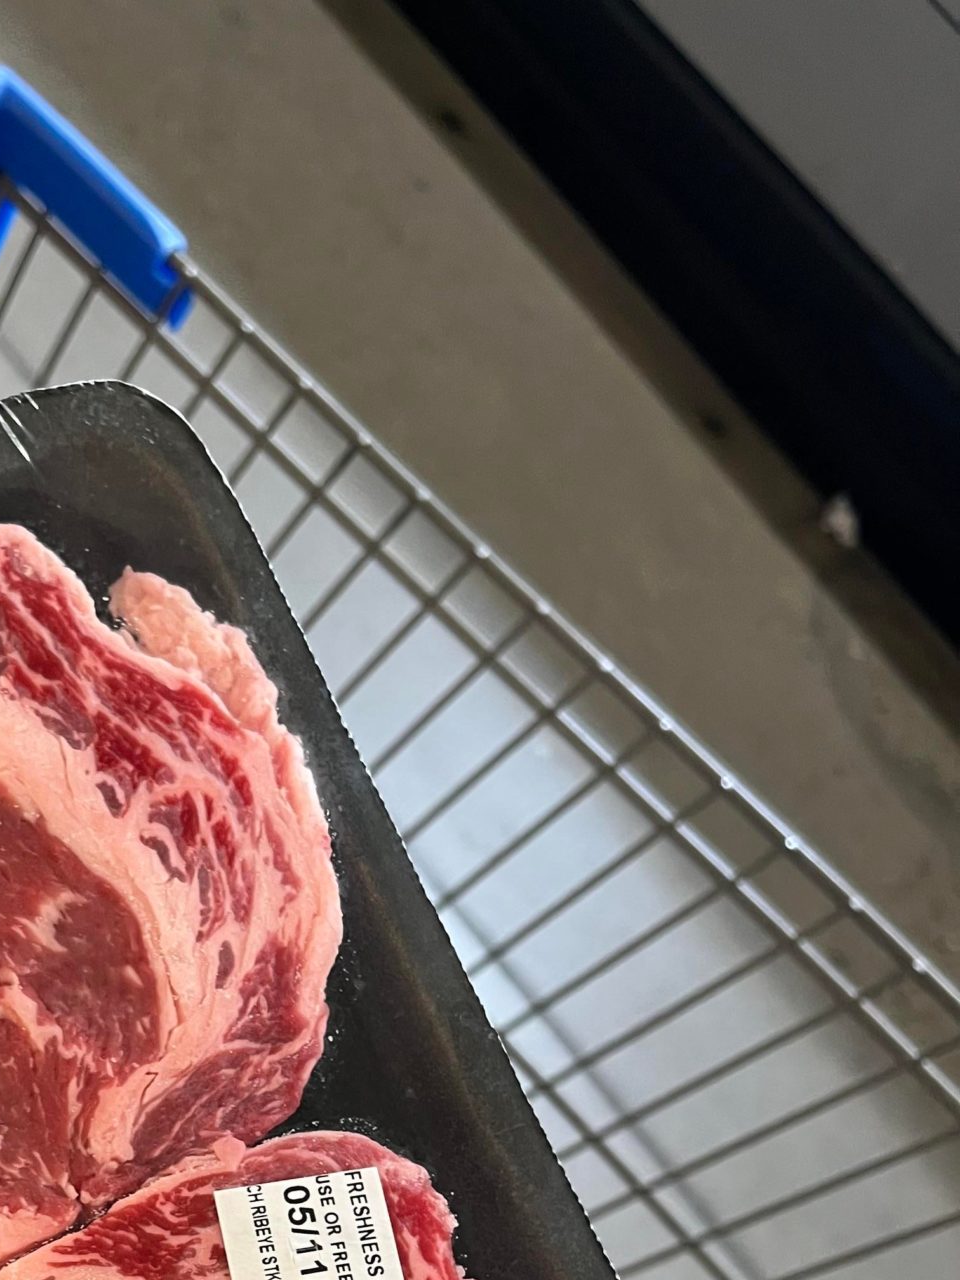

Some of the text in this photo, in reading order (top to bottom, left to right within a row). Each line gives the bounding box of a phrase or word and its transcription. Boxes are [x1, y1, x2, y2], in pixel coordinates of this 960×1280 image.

[246, 1184, 265, 1203] CH
[315, 1174, 336, 1207] USE
[250, 1205, 276, 1254] RIBEYE
[323, 1211, 342, 1236] OR
[344, 1170, 385, 1277] FRESHNESS
